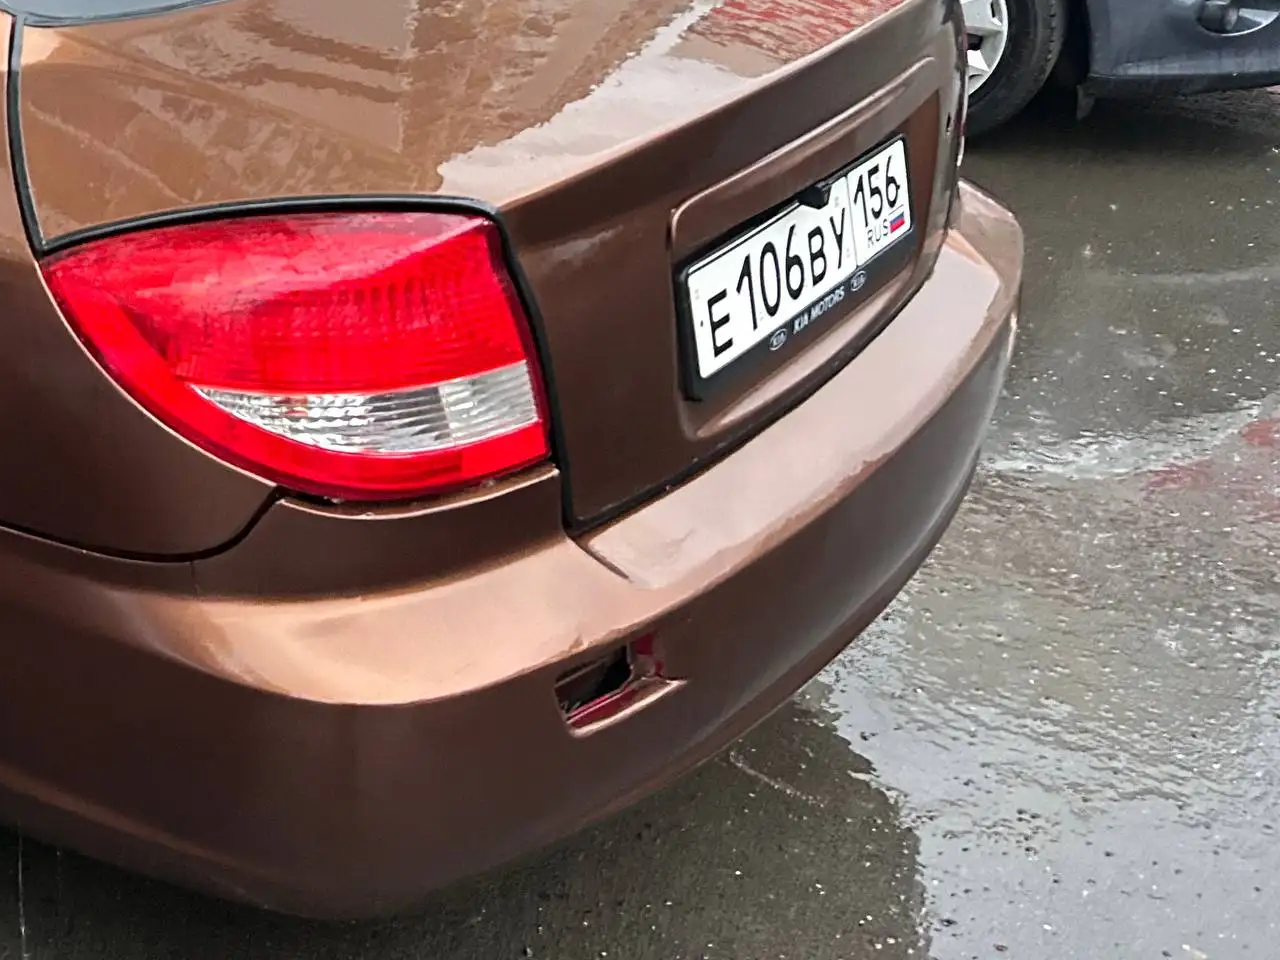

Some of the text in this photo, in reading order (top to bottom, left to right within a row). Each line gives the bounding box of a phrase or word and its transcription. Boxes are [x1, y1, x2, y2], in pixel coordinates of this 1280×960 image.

[853, 154, 900, 228] 156
[867, 218, 889, 249] RUS
[793, 285, 845, 334] KIA MOTORS
